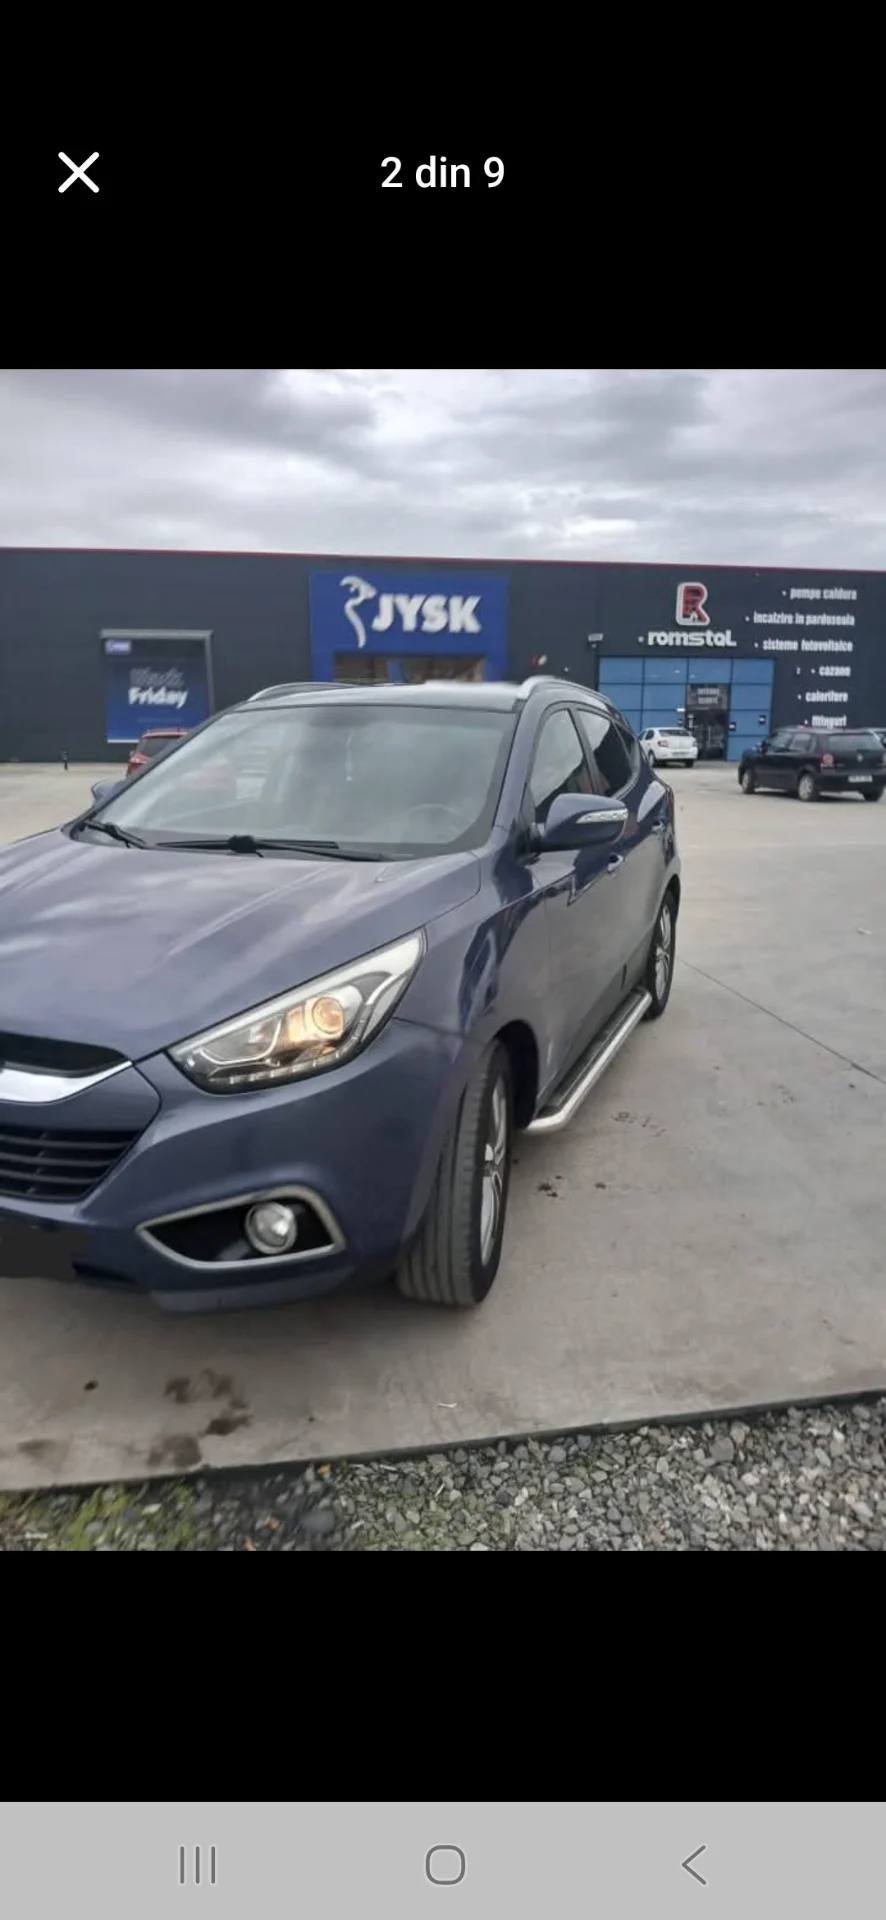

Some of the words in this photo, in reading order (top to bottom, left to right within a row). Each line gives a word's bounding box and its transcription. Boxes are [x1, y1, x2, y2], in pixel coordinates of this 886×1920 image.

[371, 593, 482, 634] JYSK
[762, 639, 799, 651] sisteme
[801, 639, 853, 652] fotovoltaice
[818, 665, 851, 677] cazane
[127, 686, 188, 710] Friday
[805, 690, 848, 703] calorifere
